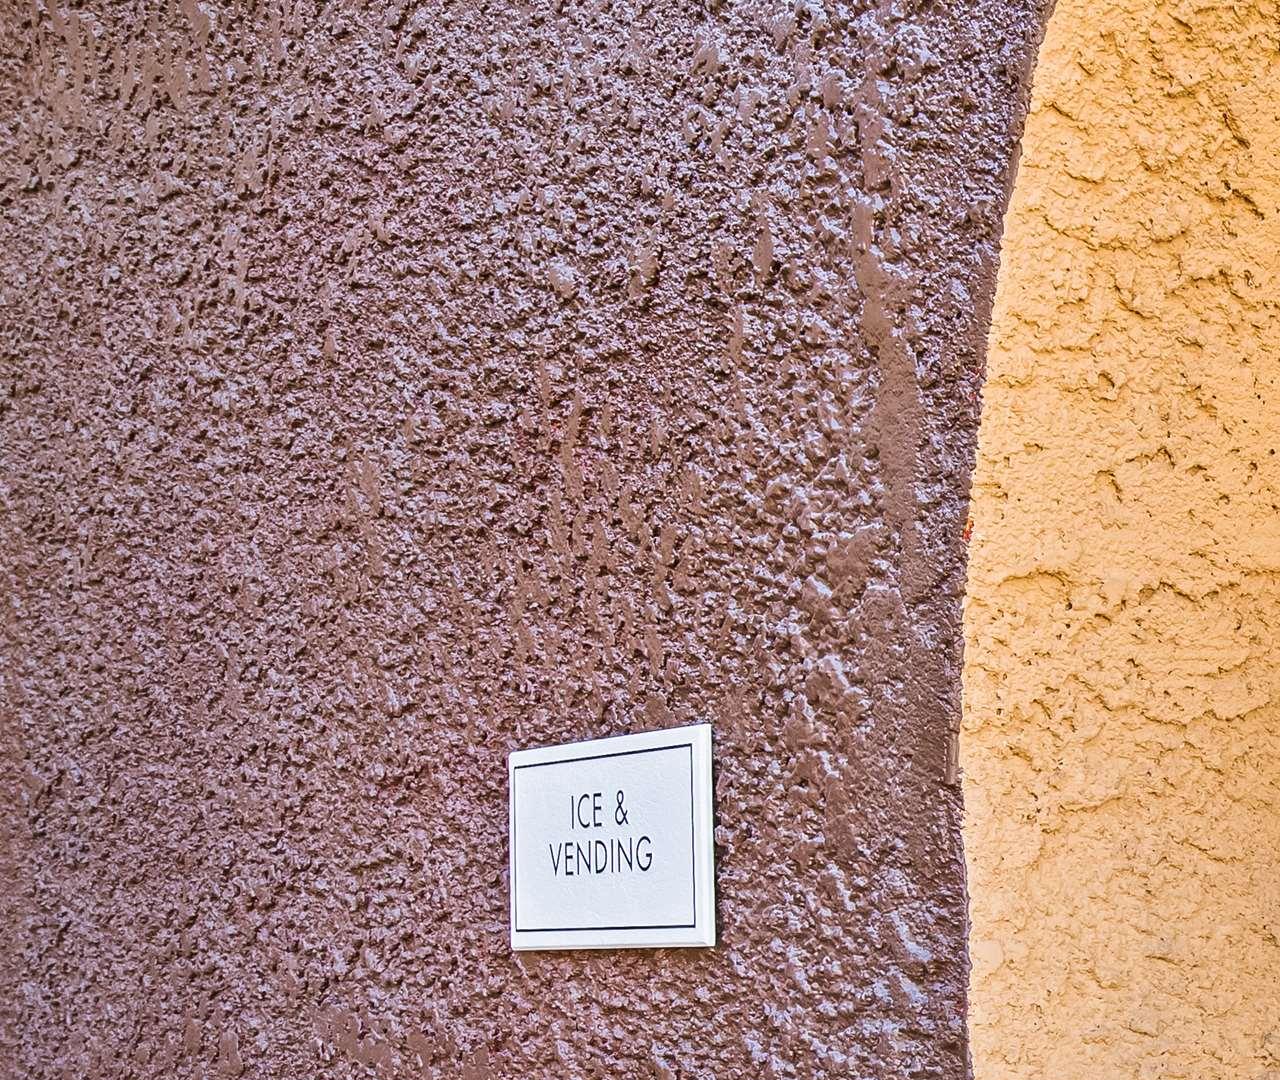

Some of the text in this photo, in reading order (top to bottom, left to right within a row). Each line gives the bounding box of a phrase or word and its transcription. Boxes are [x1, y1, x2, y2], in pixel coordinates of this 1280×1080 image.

[570, 789, 629, 829] ICE &
[549, 835, 653, 877] VENDING
